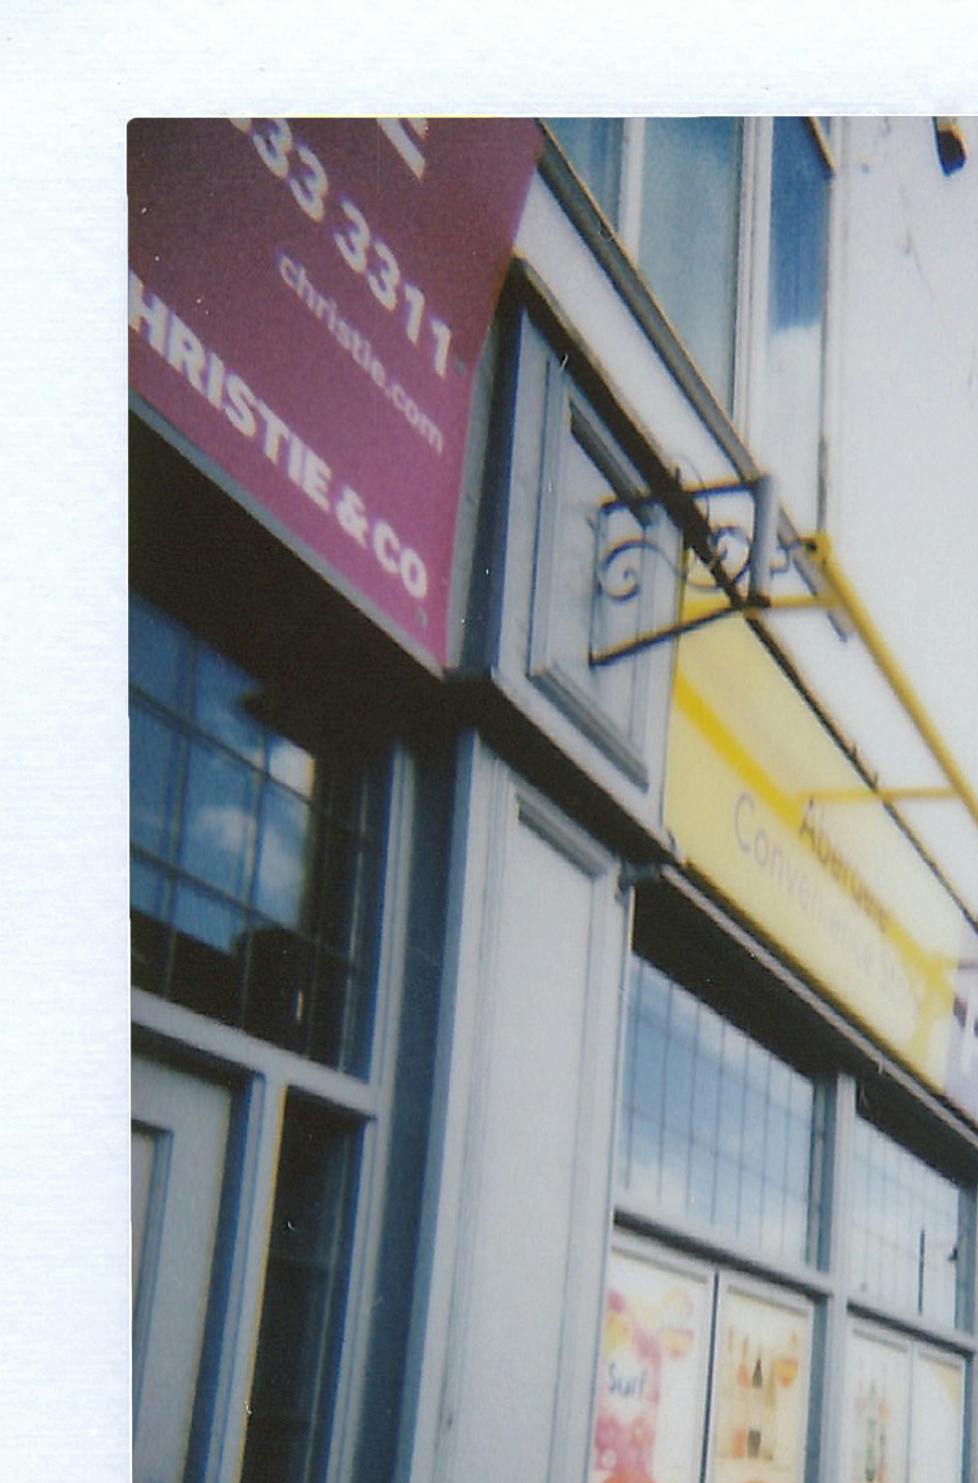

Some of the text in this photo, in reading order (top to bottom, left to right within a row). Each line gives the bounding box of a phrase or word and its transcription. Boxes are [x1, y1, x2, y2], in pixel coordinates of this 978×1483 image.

[229, 117, 328, 223] 33
[335, 200, 451, 378] 3311
[280, 255, 445, 456] christie.com
[336, 487, 368, 547] &
[373, 521, 427, 598] CO
